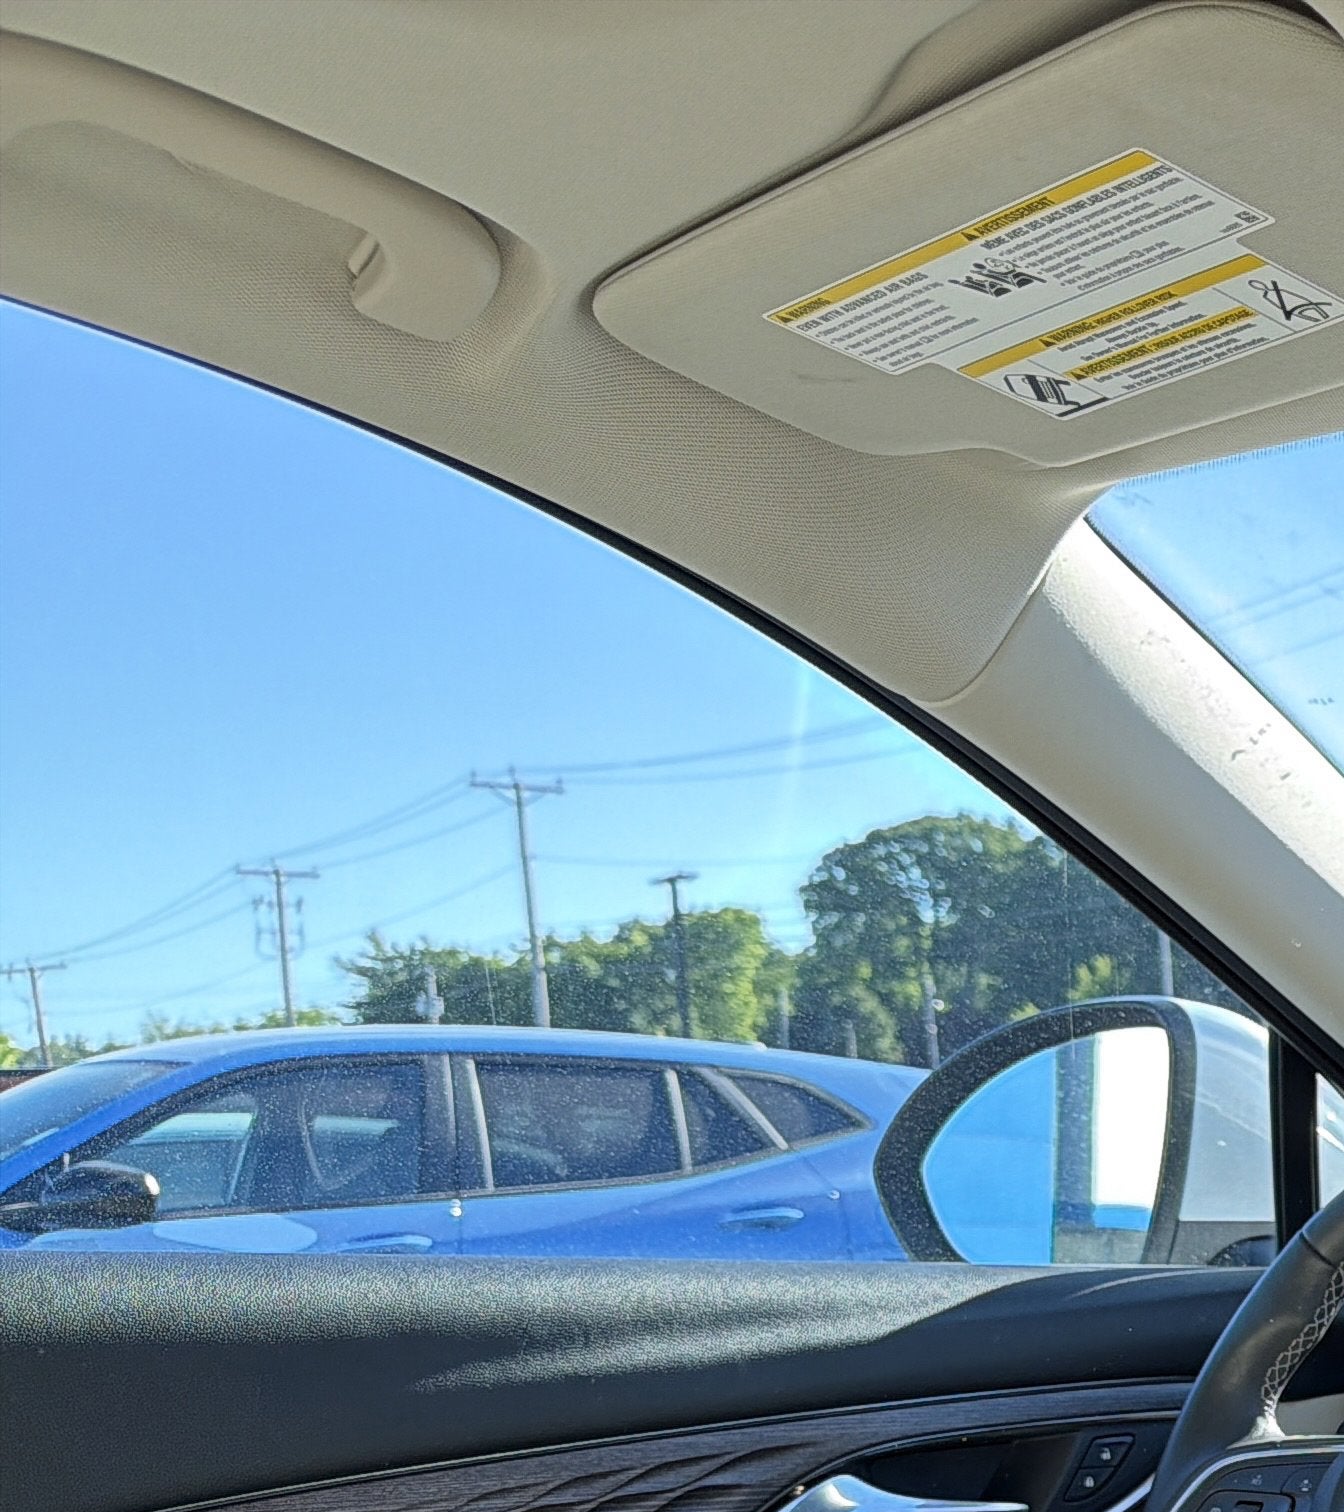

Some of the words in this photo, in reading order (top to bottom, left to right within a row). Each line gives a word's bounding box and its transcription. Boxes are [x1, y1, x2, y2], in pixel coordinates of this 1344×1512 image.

[974, 196, 1057, 235] AVERTISSEMENT
[787, 297, 831, 319] WARNING
[797, 318, 823, 331] EVEN
[818, 309, 845, 322] WITH
[840, 289, 889, 312] ADVANCED
[884, 282, 905, 293] AIR
[900, 271, 929, 286] BAGS
